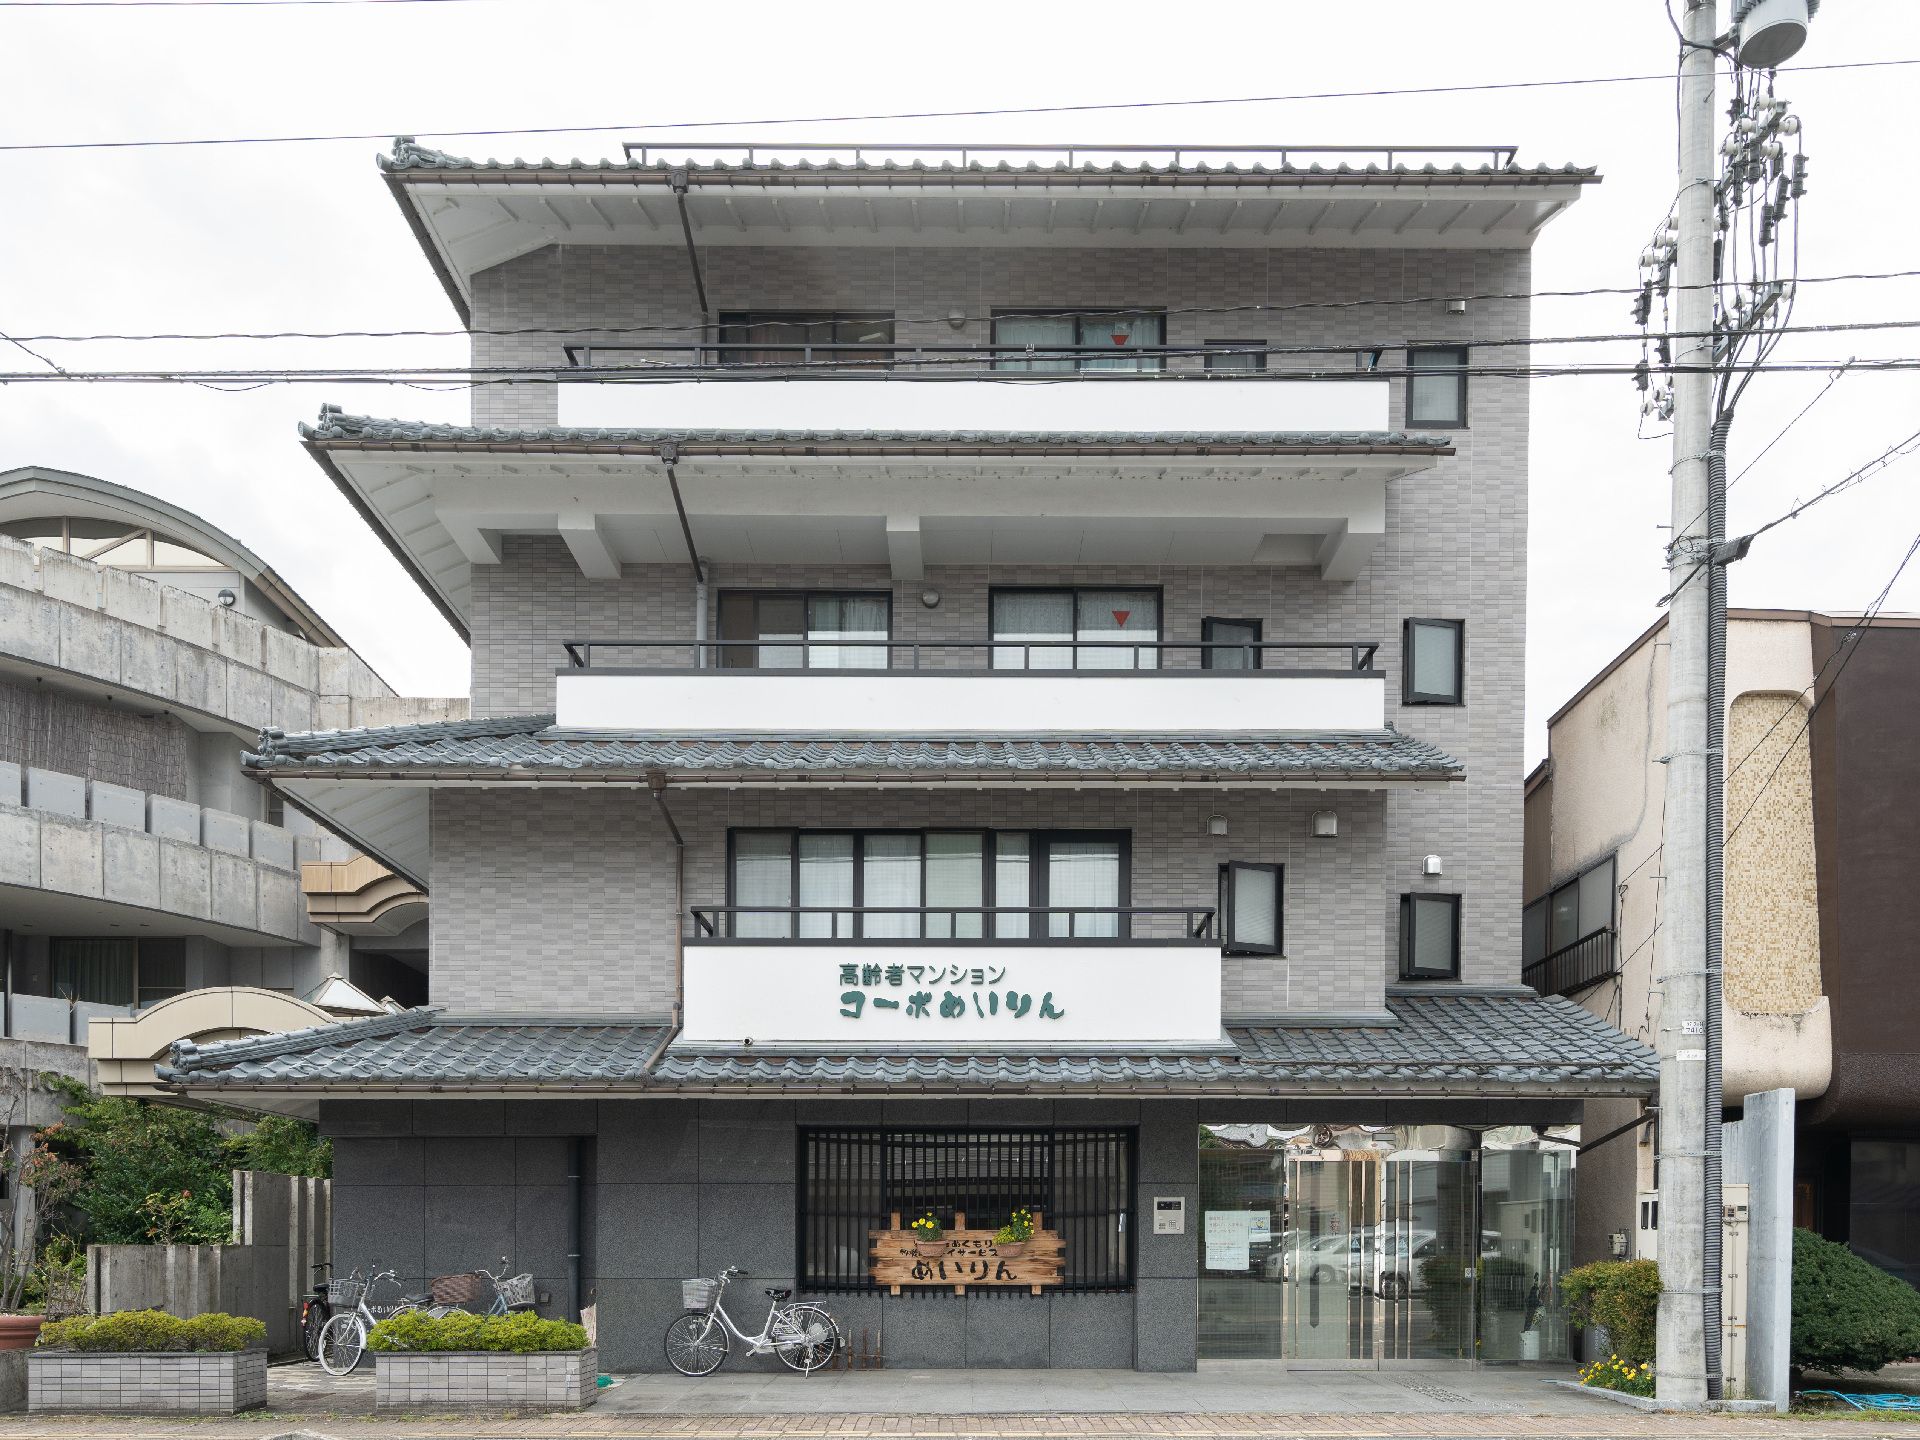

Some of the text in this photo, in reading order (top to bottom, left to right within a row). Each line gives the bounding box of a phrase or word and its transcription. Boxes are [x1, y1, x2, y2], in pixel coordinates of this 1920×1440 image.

[839, 963, 1006, 986] 高齢者マンション
[840, 990, 1065, 1019] コーポめいりん
[912, 1260, 1017, 1281] めいりん
